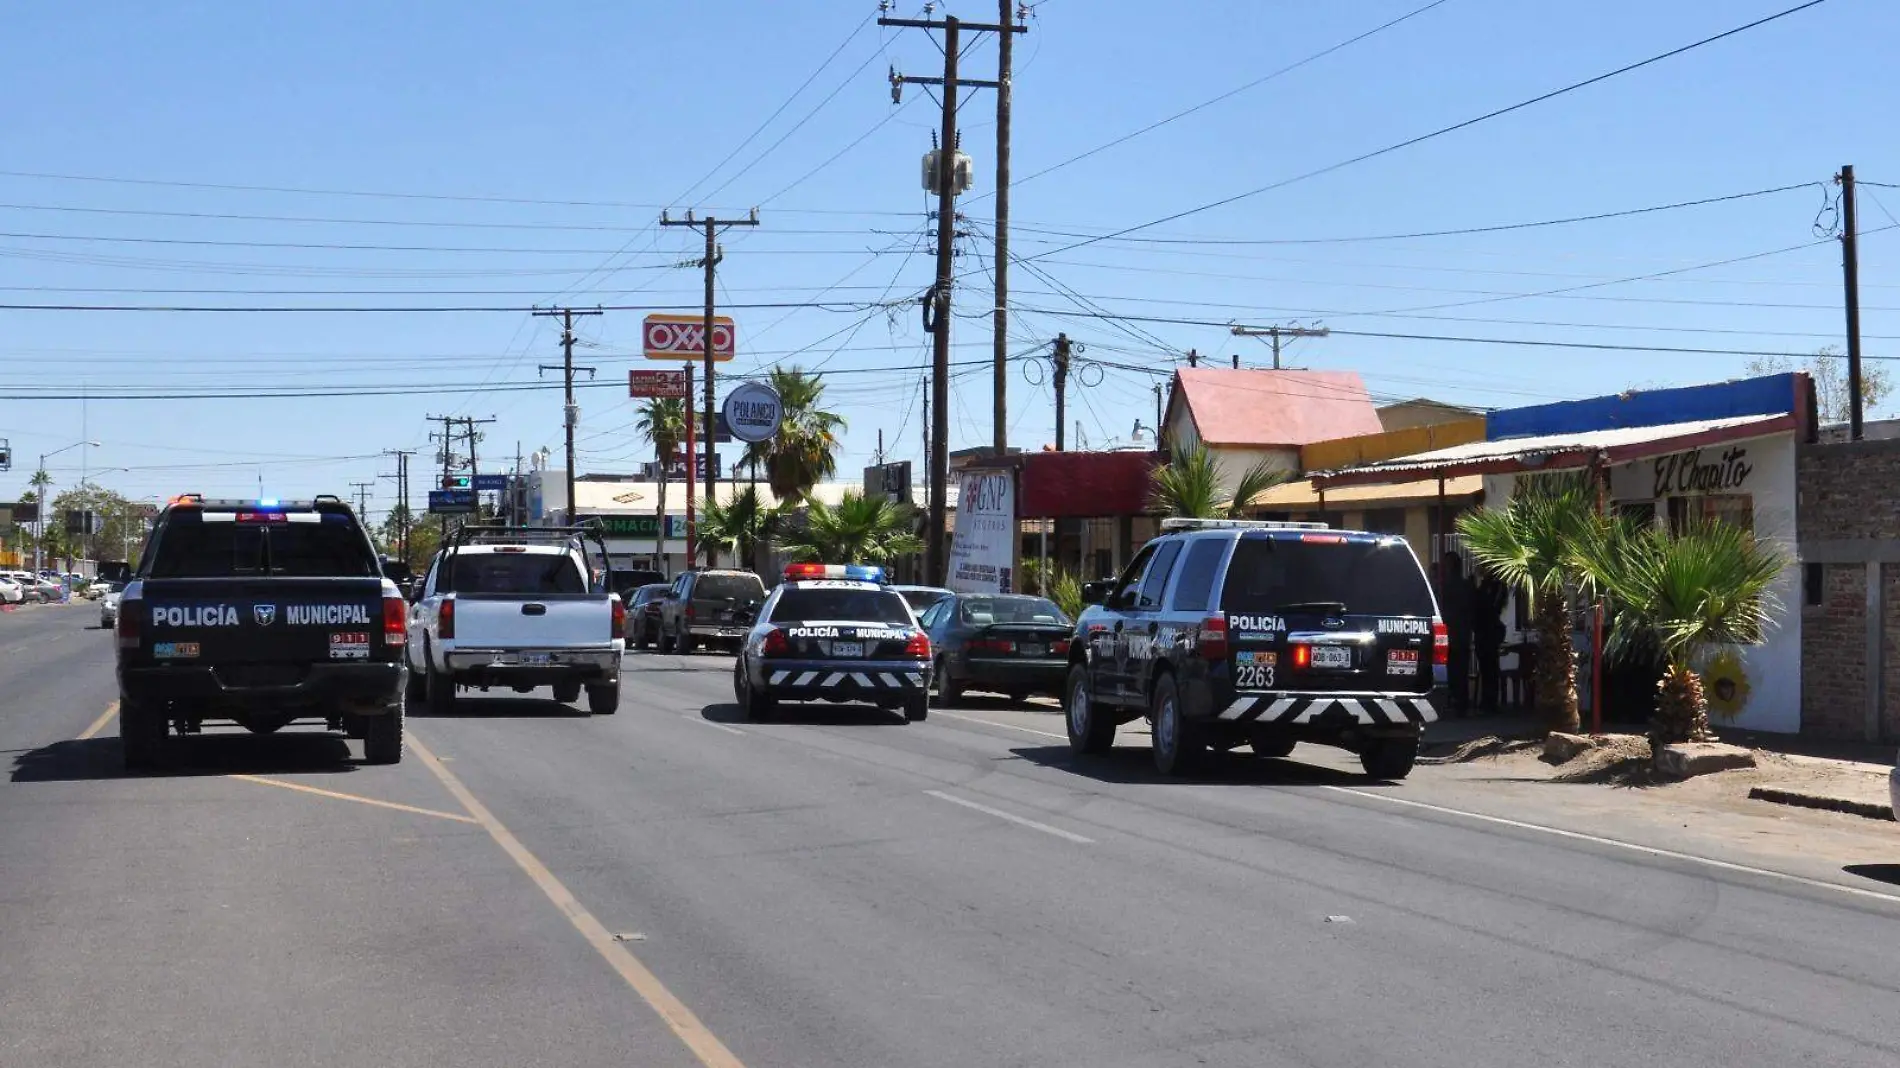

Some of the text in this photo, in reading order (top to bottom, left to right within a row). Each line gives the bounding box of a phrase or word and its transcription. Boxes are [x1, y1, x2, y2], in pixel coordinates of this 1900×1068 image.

[649, 324, 731, 351] OXXO
[733, 400, 775, 419] POLANCO
[1654, 453, 1679, 498] El
[1678, 446, 1753, 496] Chapito
[977, 475, 1007, 510] GNP
[153, 603, 370, 626] POLICÍA MUNICIPAL
[1229, 615, 1430, 634] POLICÍA MUNICIPAL
[333, 634, 366, 643] 911
[789, 626, 906, 639] POLICÍA MUNICIPAL
[1235, 666, 1274, 687] 2263
